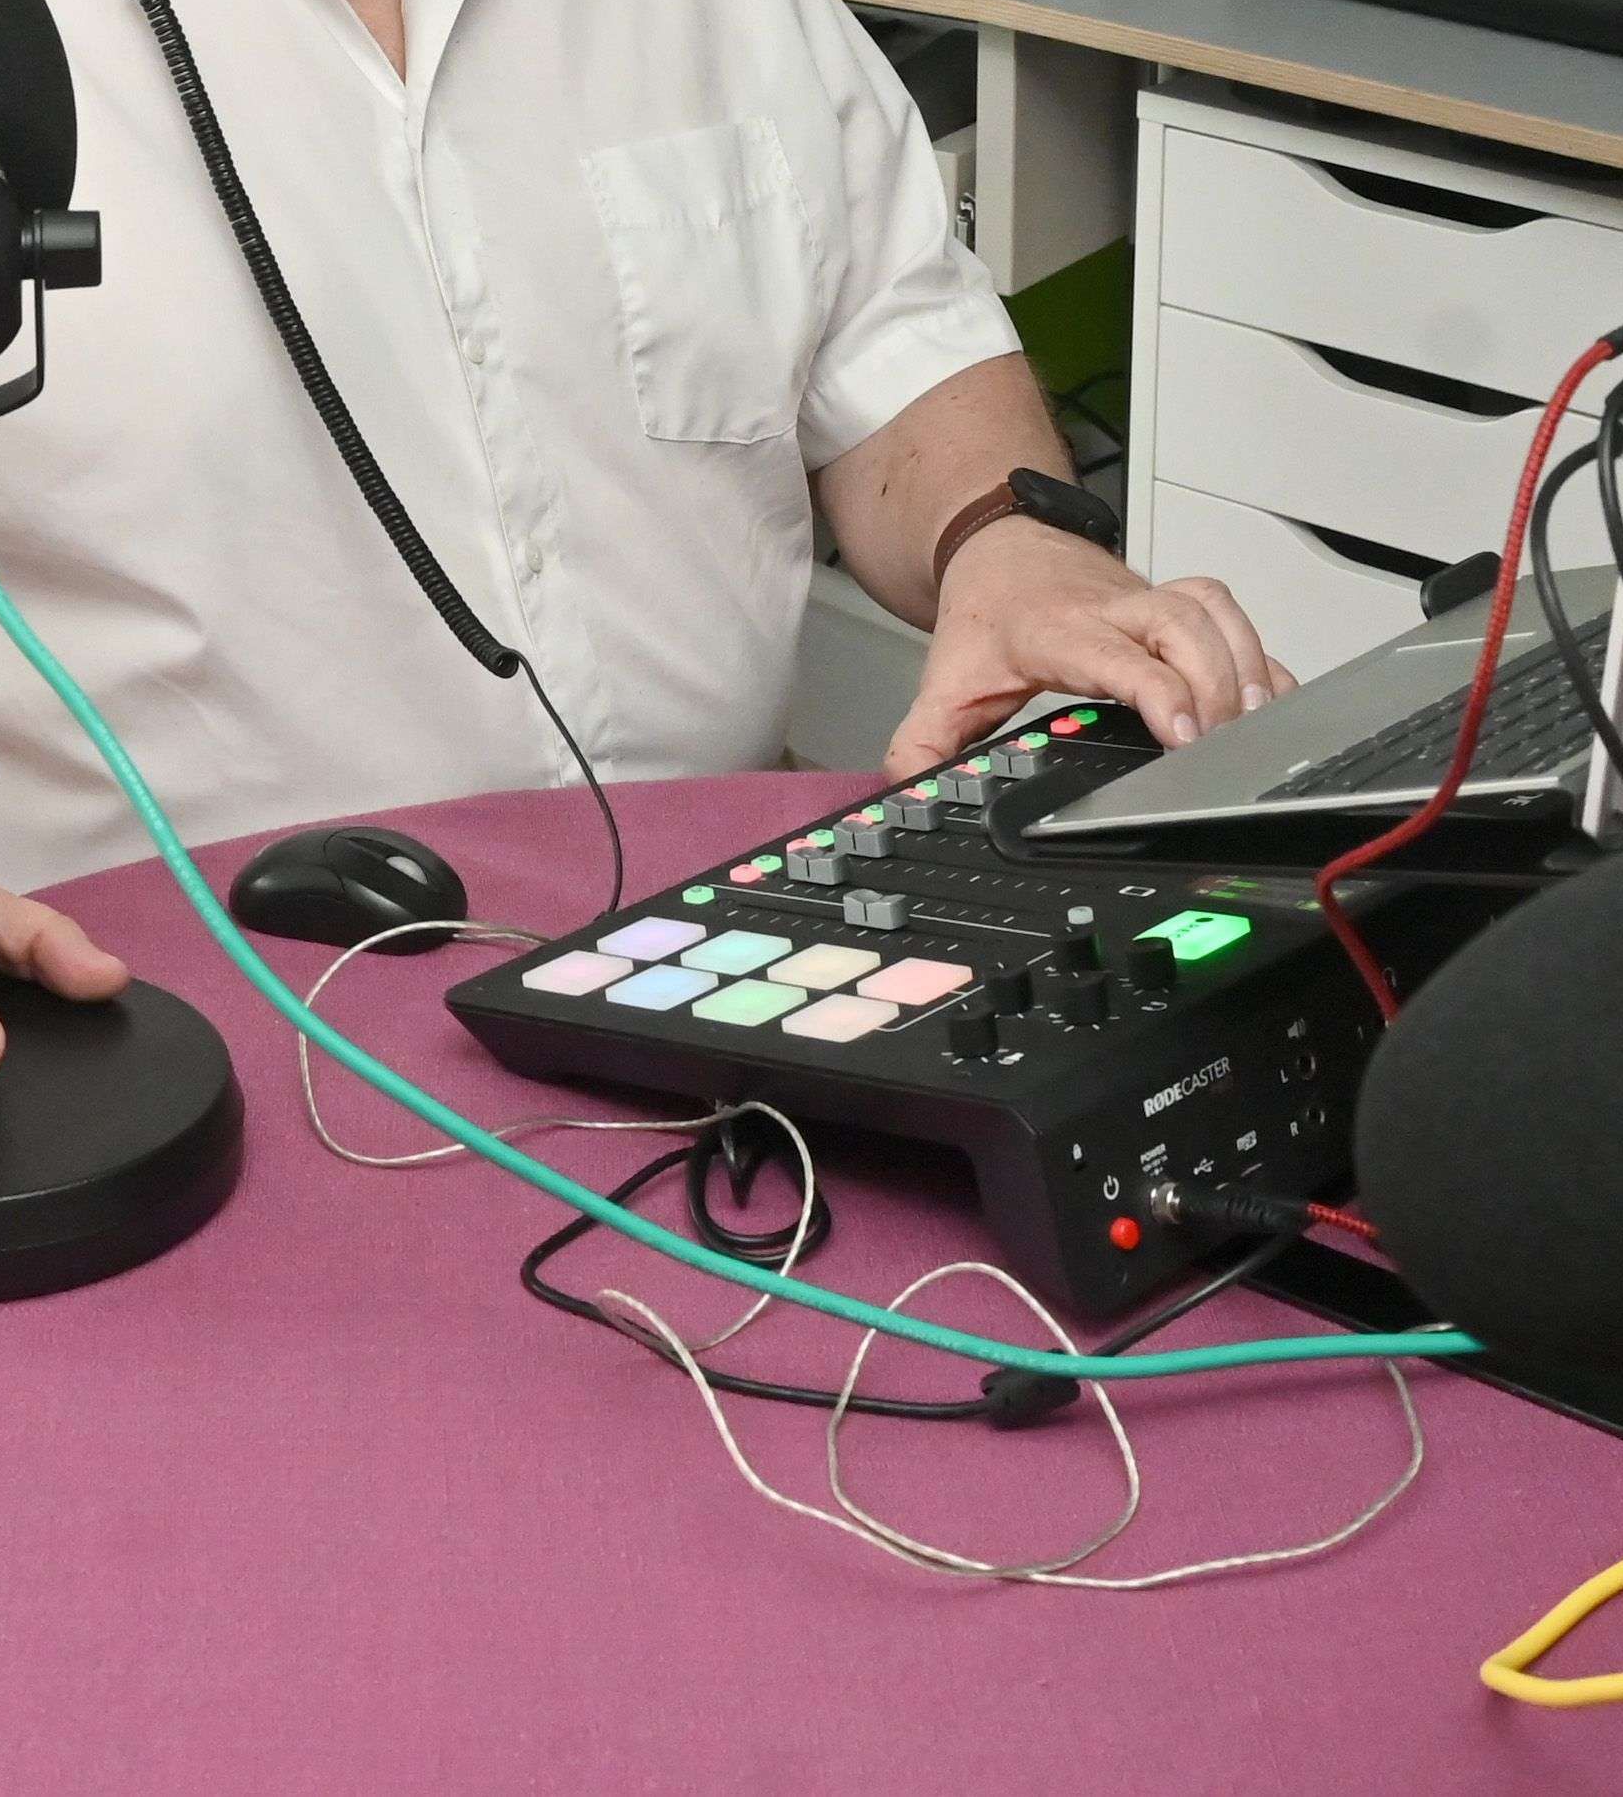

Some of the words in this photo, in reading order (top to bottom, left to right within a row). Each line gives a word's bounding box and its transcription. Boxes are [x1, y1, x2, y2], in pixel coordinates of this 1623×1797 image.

[1280, 1069, 1289, 1084] L
[1143, 1056, 1231, 1118] RØDECASTER
[1289, 1121, 1299, 1137] R
